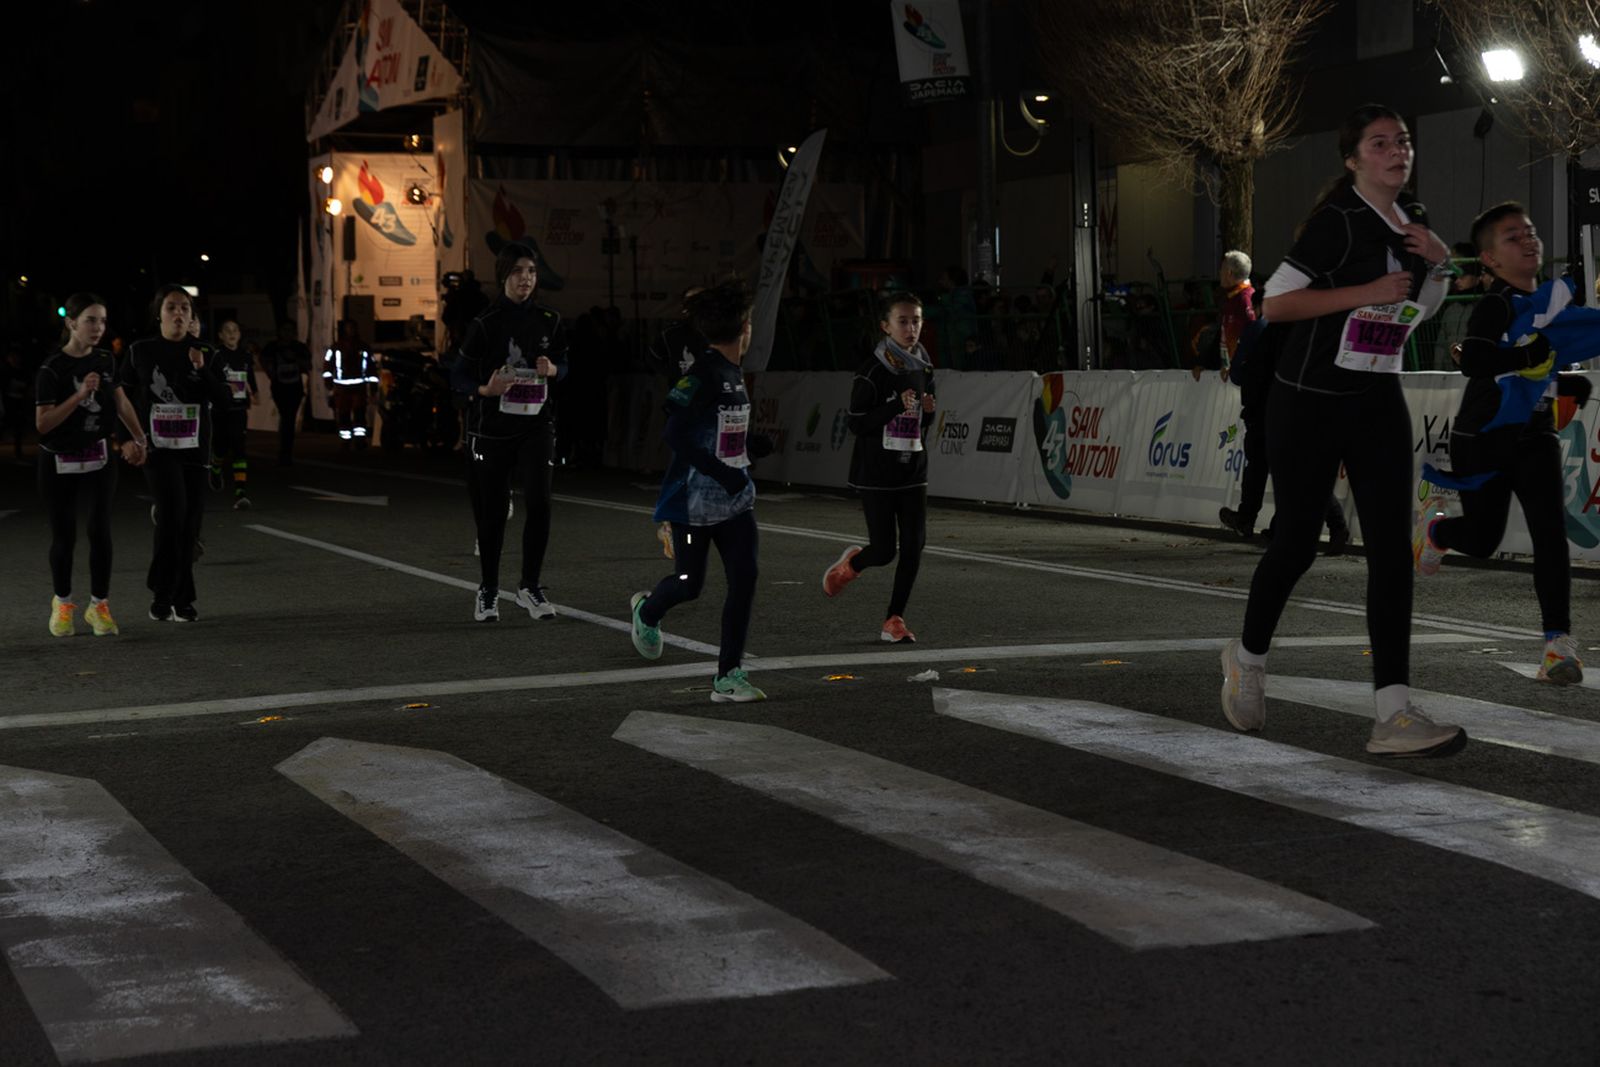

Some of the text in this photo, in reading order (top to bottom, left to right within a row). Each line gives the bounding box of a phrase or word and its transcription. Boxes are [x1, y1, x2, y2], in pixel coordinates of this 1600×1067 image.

[909, 79, 964, 91] DACIA
[911, 87, 966, 99] JAPEMASA
[370, 206, 396, 233] 43
[942, 422, 969, 439] FISIO
[984, 423, 1012, 433] DACIA
[1068, 406, 1105, 439] SAN
[1062, 435, 1121, 479] ANTÓN
